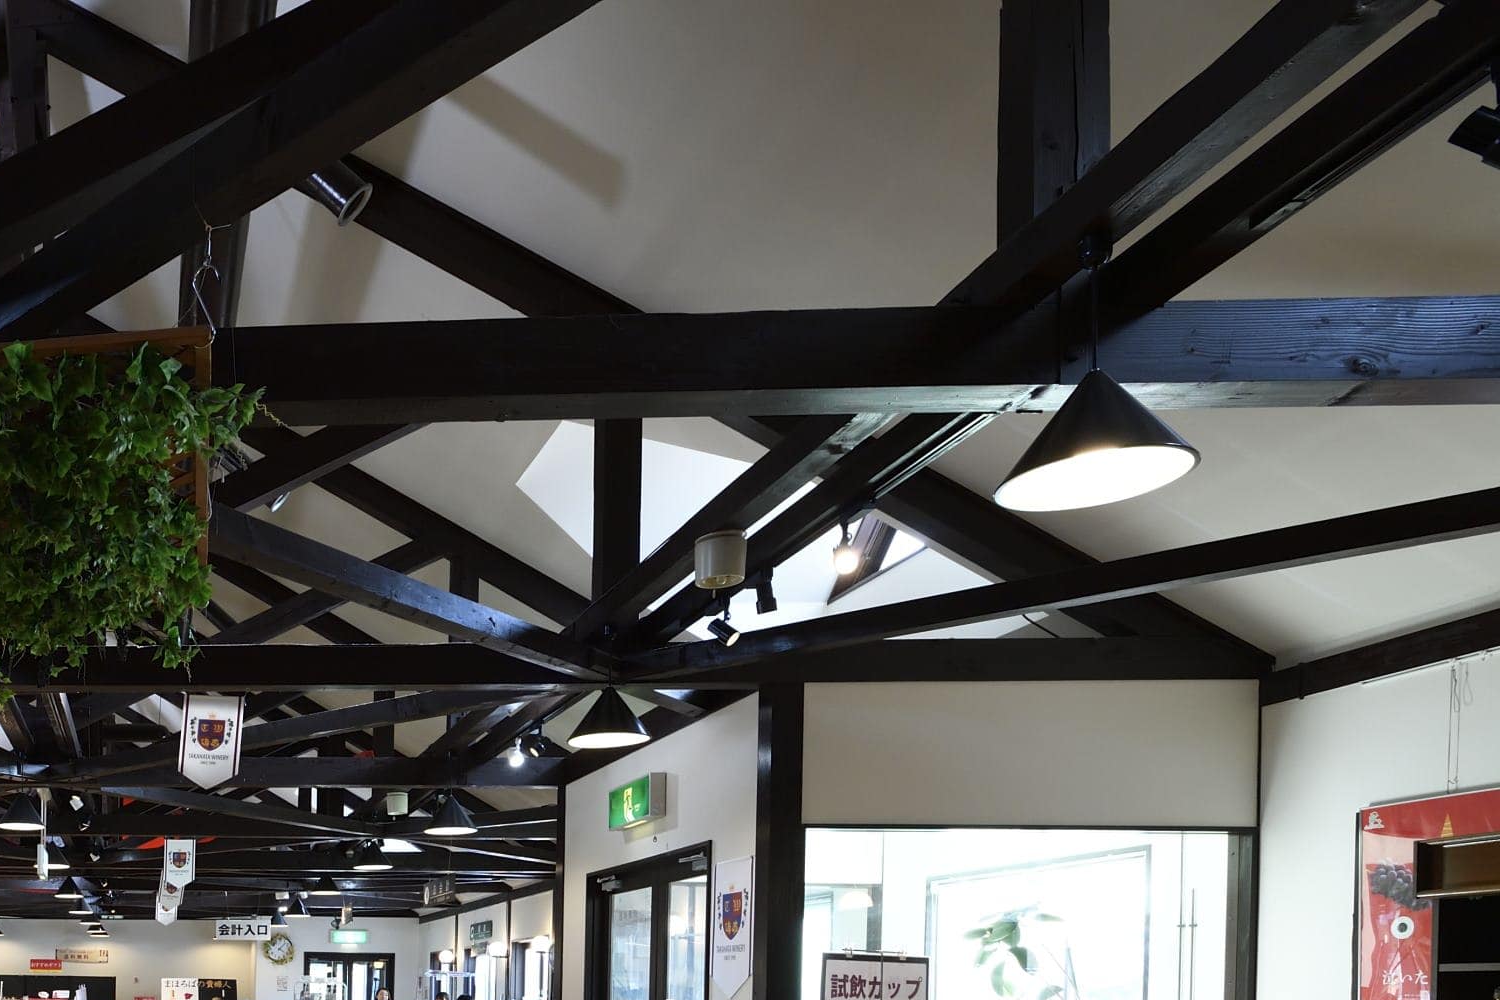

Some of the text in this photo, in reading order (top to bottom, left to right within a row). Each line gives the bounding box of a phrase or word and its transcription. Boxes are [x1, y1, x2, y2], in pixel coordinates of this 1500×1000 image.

[218, 924, 268, 936] 会計入口
[830, 974, 923, 1000] 試飲カップ
